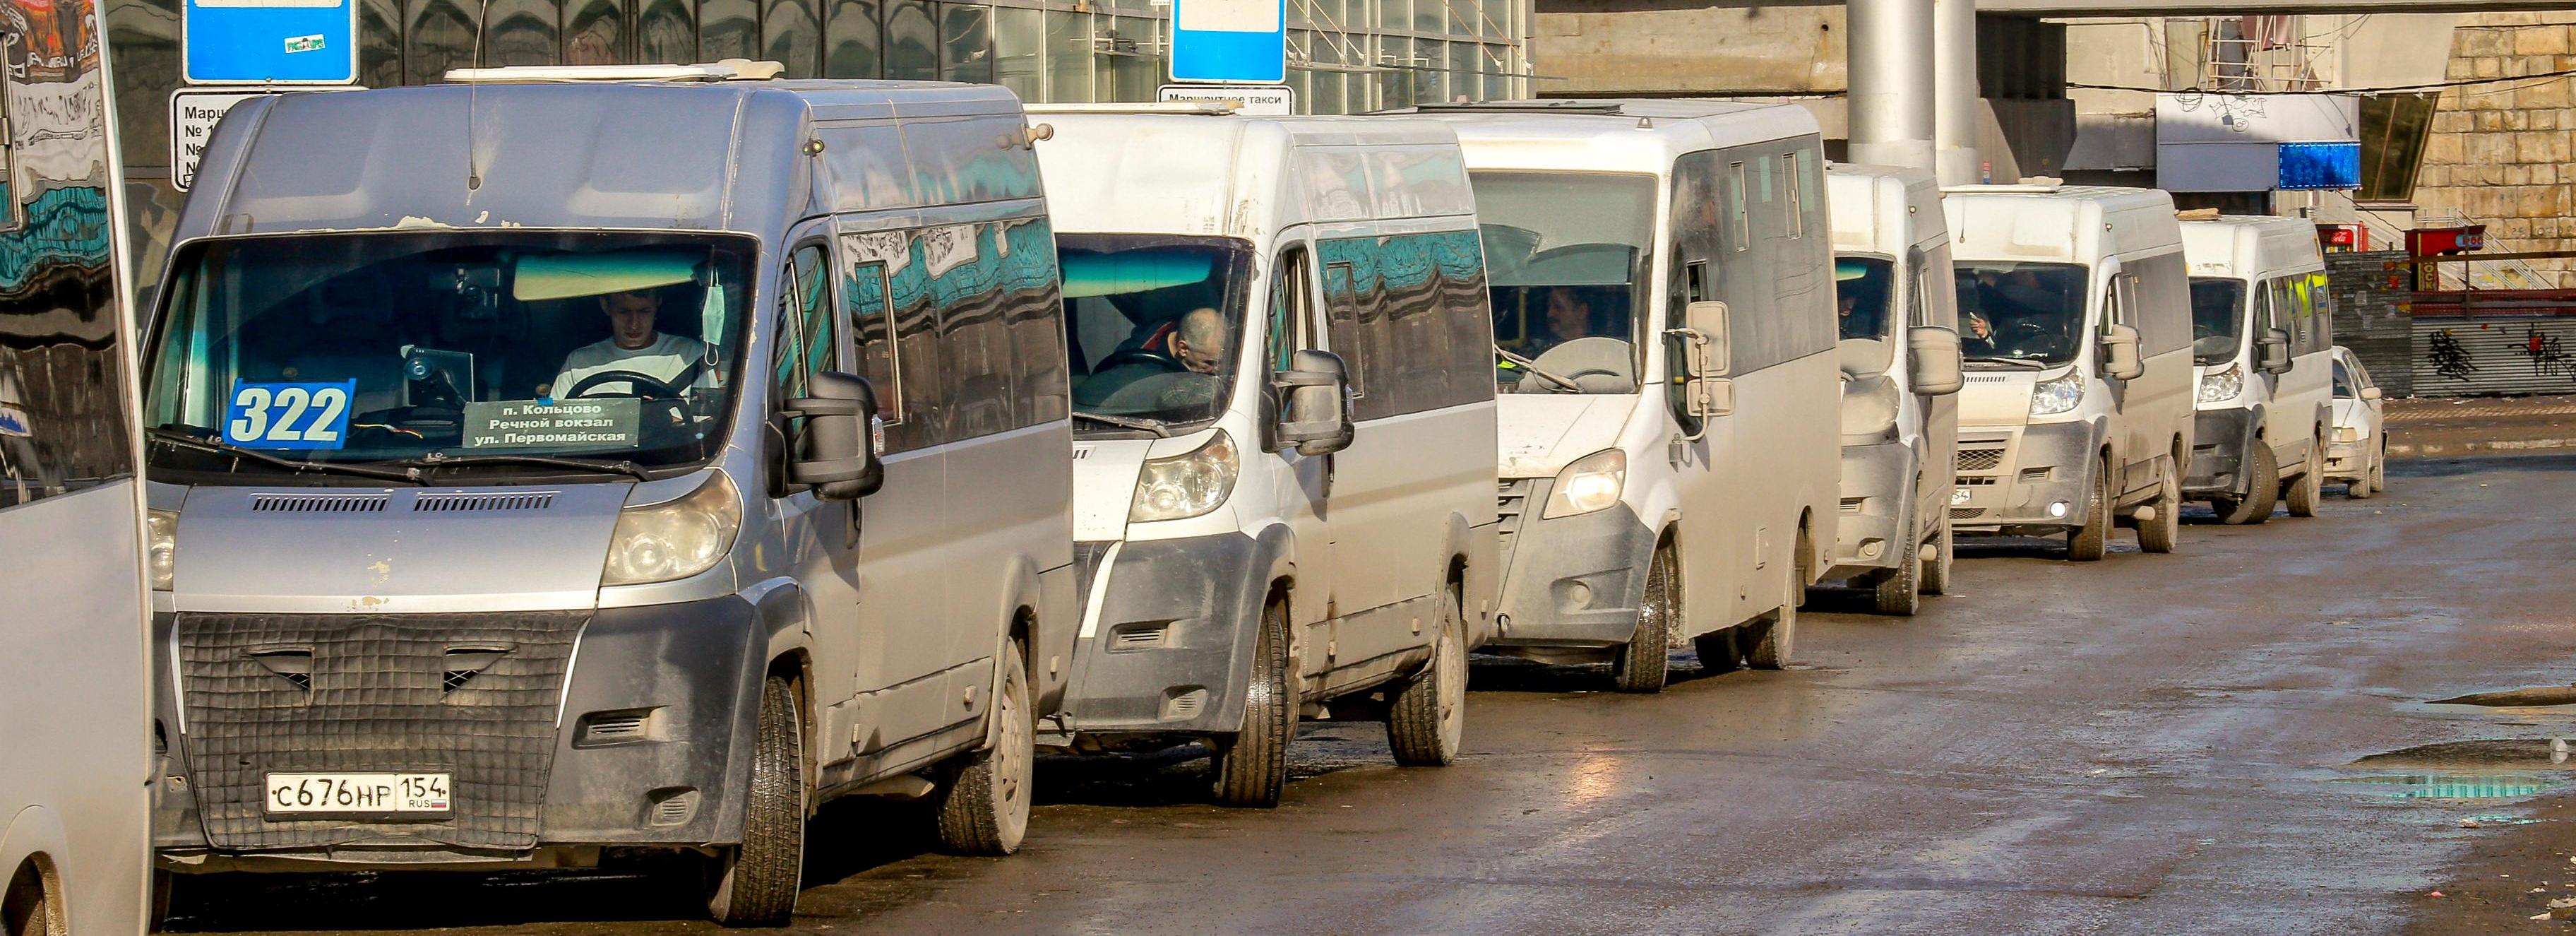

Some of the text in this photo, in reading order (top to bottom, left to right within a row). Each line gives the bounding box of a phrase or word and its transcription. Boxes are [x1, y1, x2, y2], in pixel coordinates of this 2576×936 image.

[1250, 95, 1282, 104] такси
[2423, 262, 2434, 289] ОСК
[230, 388, 347, 442] 322
[503, 405, 602, 416] п. Кольцово
[489, 417, 614, 430] Речной вокзал
[475, 432, 626, 446] ул. Первомайская
[400, 778, 442, 798] 154
